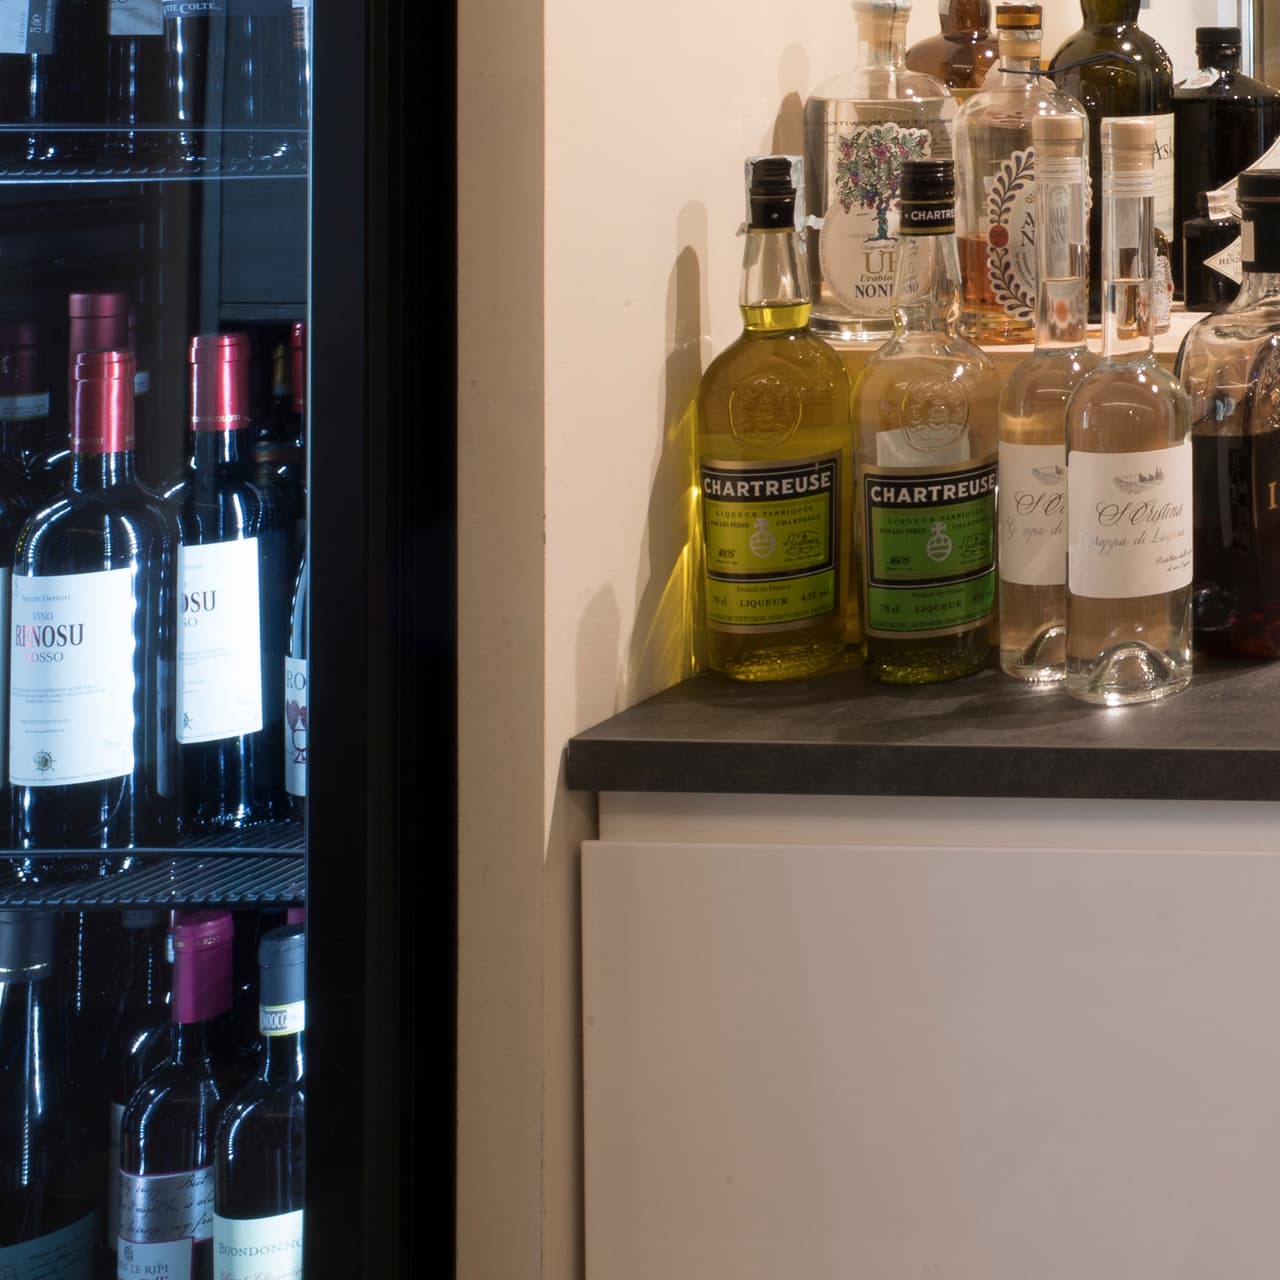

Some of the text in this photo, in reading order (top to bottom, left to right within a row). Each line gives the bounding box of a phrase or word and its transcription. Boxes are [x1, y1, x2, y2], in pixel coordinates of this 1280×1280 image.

[703, 472, 831, 497] CHARTREUSE
[870, 473, 996, 503] CHARTREUSE
[1133, 529, 1146, 546] di
[739, 597, 789, 609] LIQUEUR
[914, 601, 963, 615] LIQUEUR
[144, 1263, 169, 1275] RIPI
